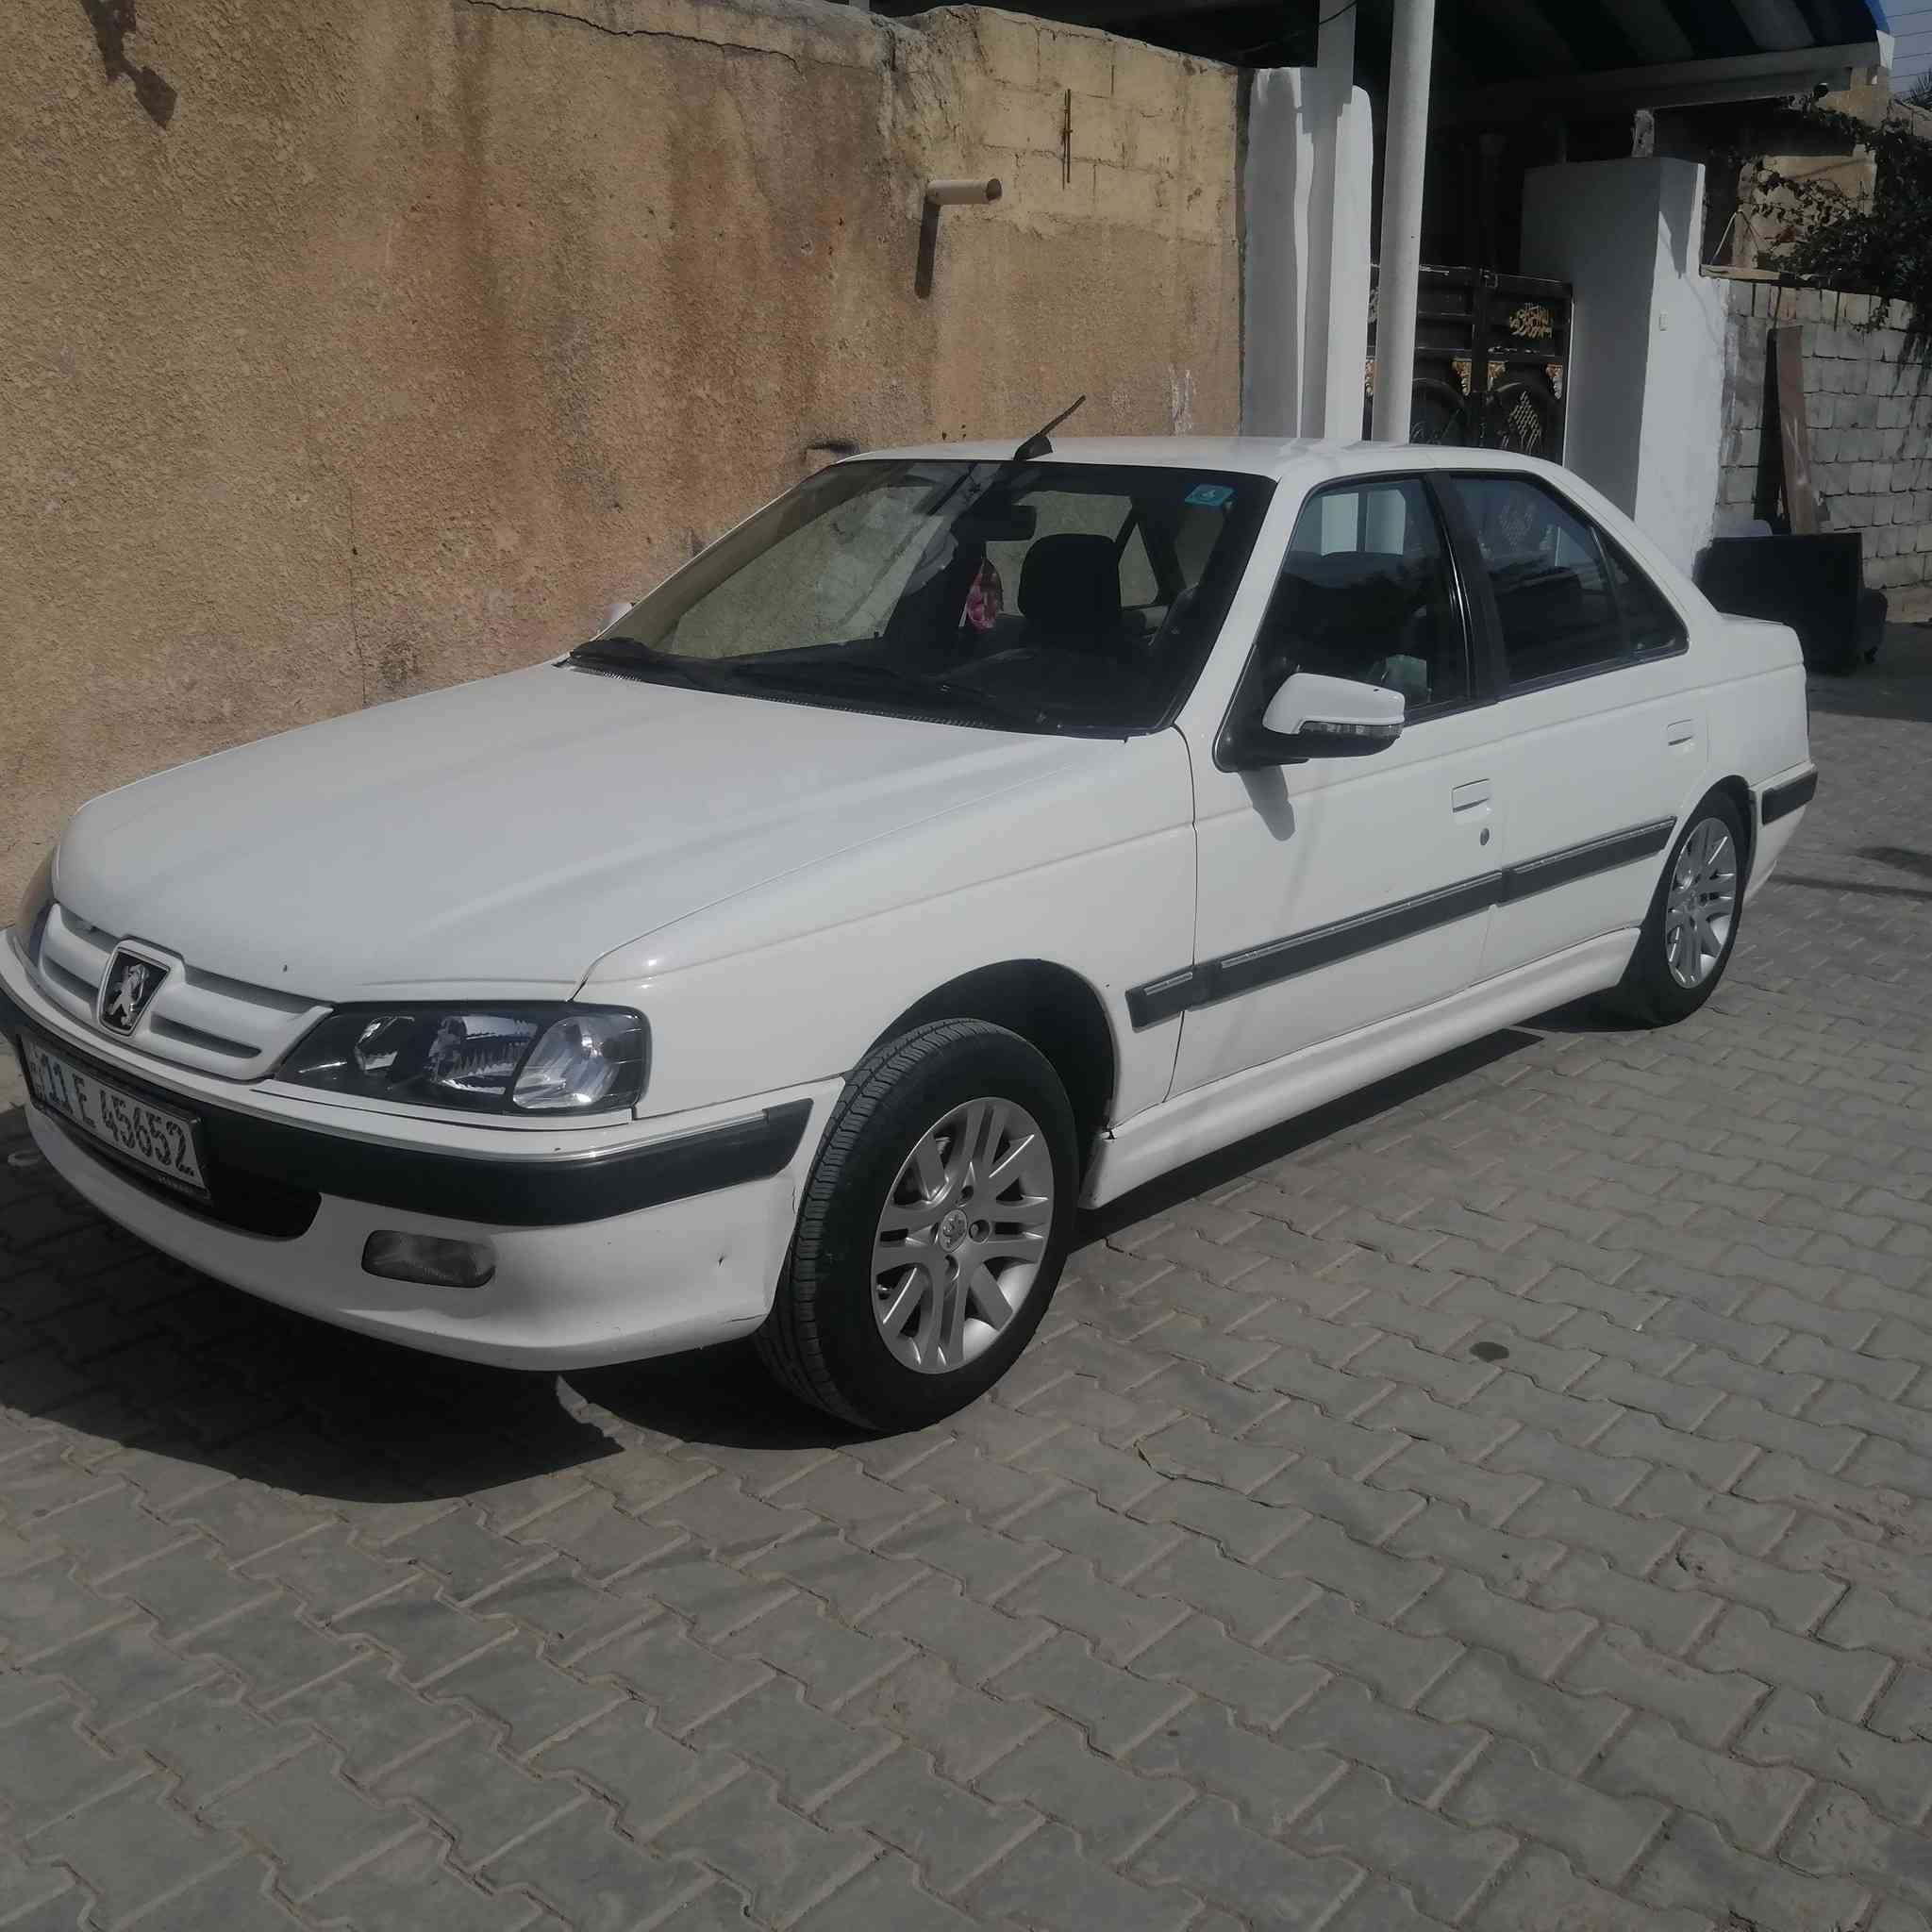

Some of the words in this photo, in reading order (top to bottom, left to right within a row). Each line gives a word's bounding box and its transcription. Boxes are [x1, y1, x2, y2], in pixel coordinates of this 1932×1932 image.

[41, 1053, 74, 1115] 11
[72, 1072, 96, 1129] E
[99, 1089, 195, 1177] 45652
